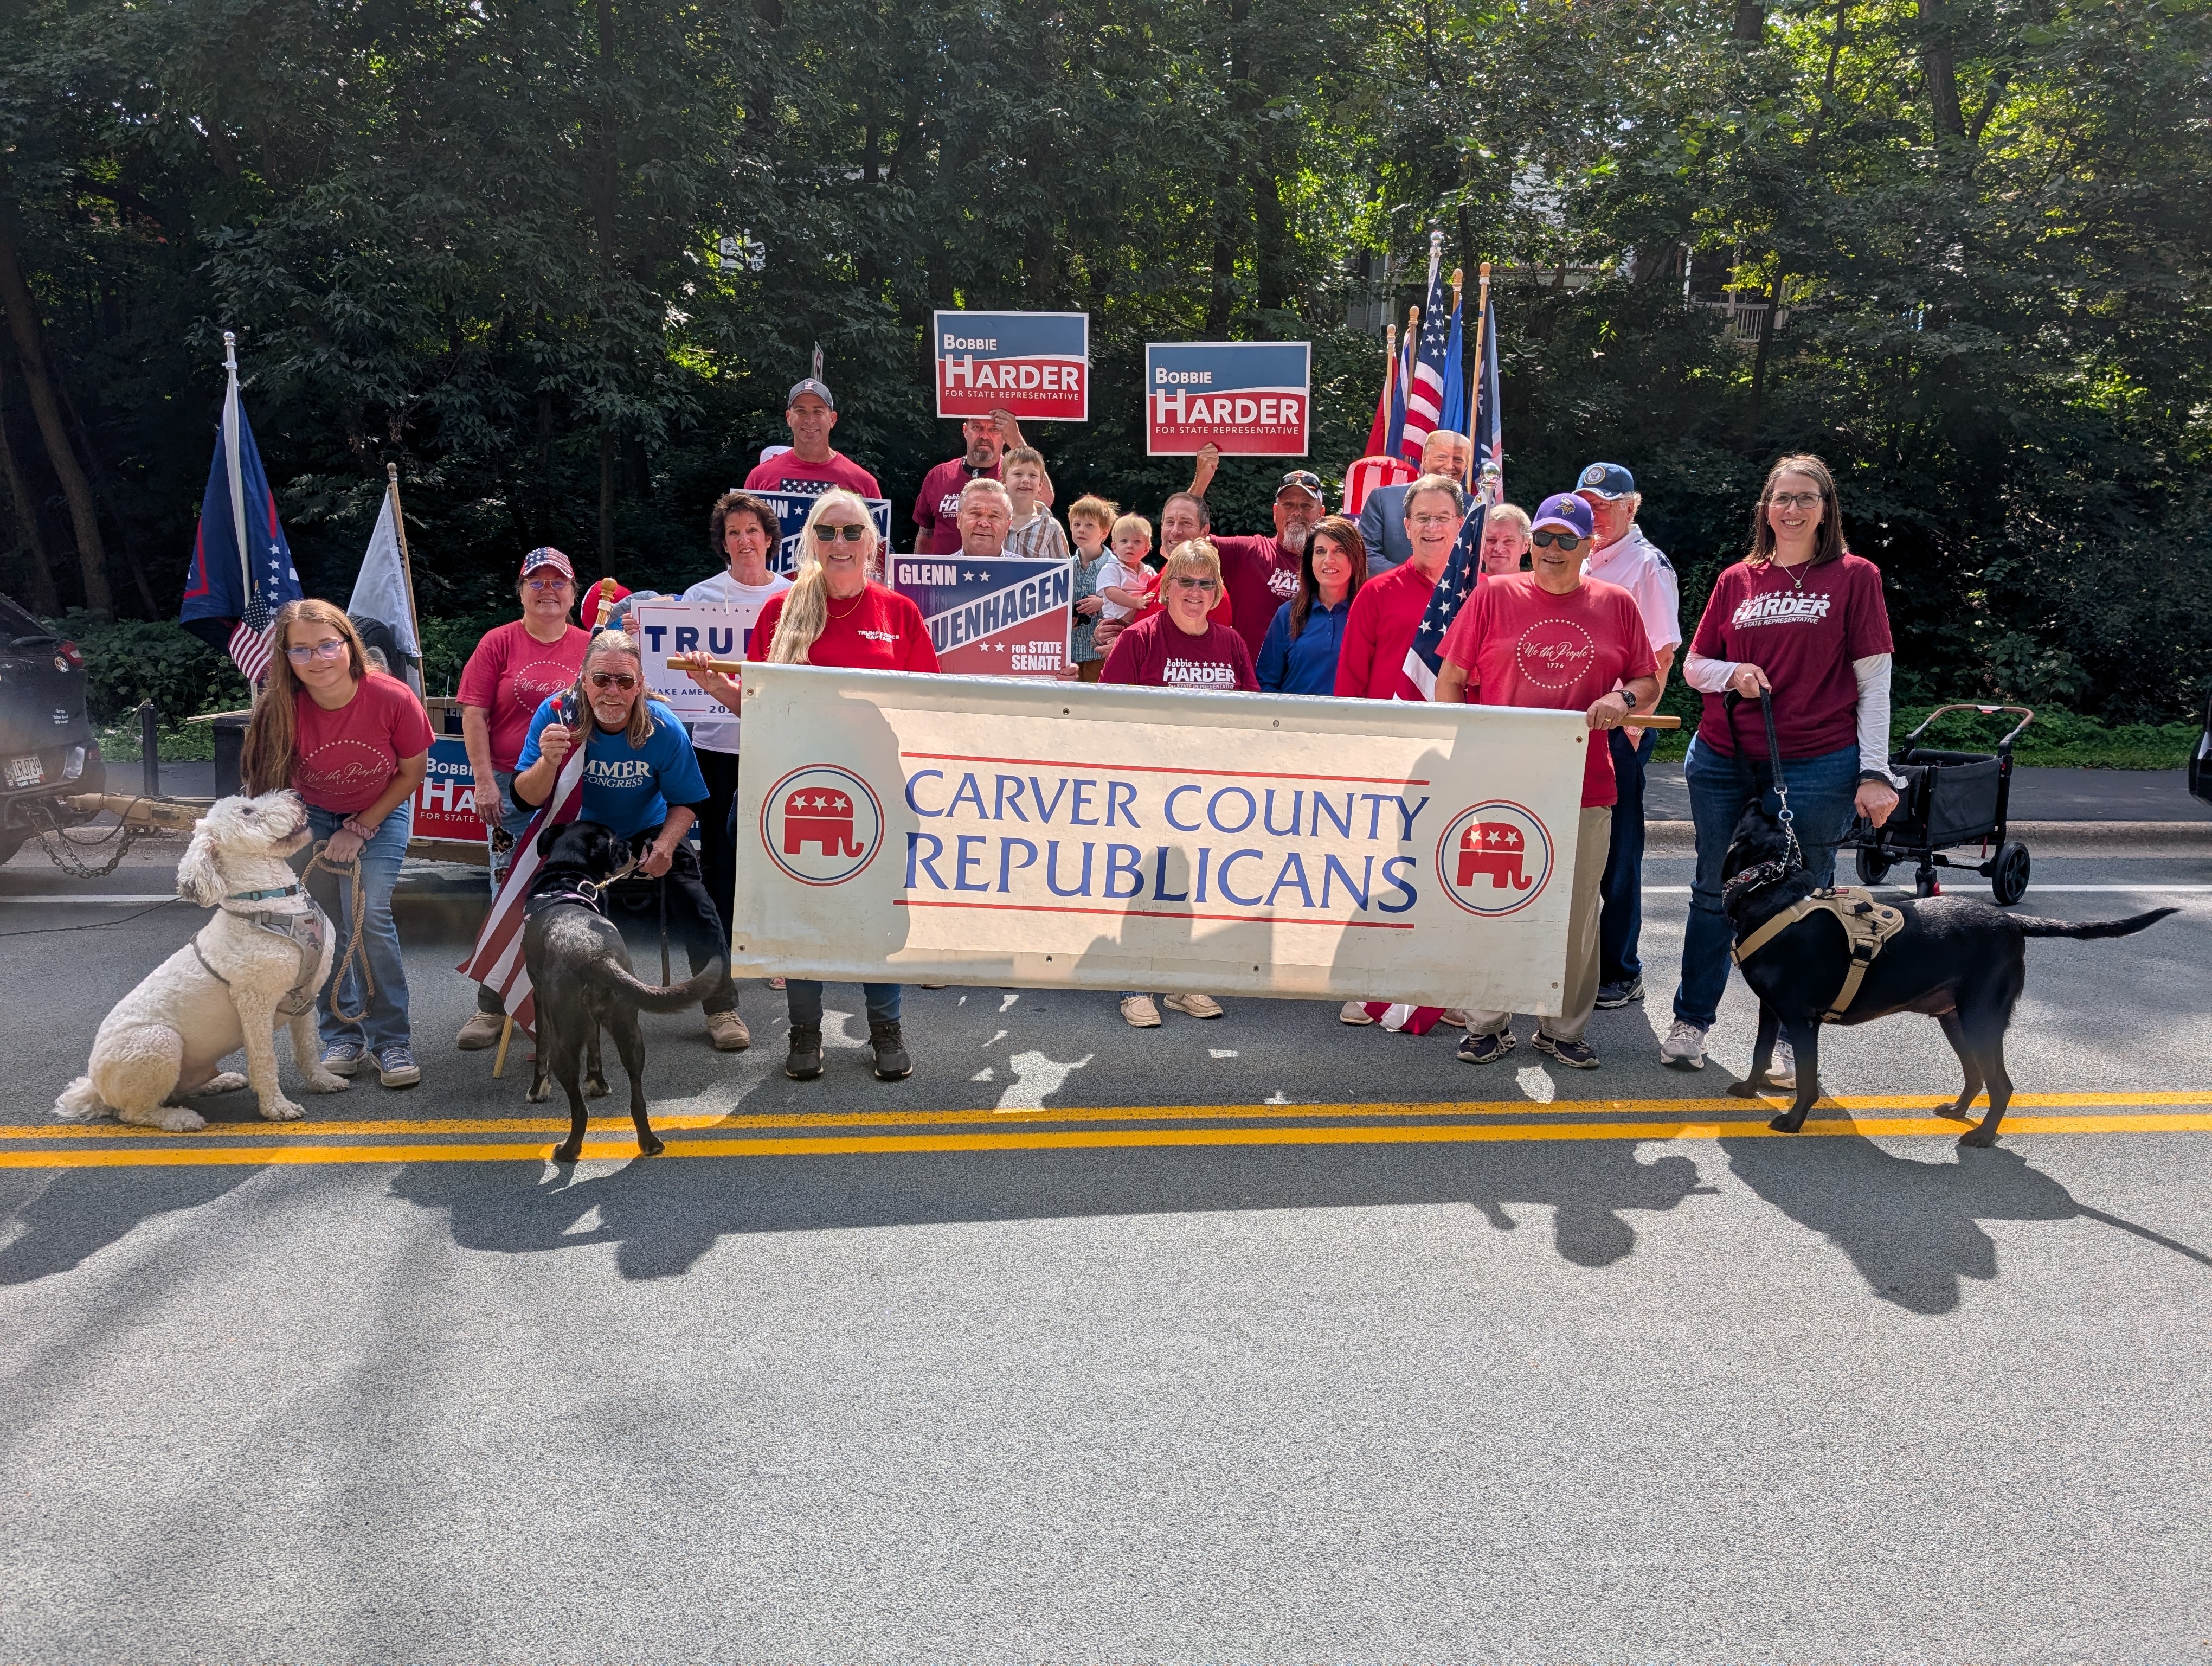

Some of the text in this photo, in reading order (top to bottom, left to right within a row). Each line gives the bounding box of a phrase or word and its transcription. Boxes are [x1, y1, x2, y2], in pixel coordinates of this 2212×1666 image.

[944, 334, 998, 350] BOBBIE
[945, 354, 1079, 391] HARDER
[1155, 367, 1212, 384] BOBBIE
[999, 392, 1079, 400] REPRESENTATIVE
[1156, 388, 1300, 425] HARDER
[1213, 426, 1299, 434] REPRESENTATIVE
[898, 563, 957, 586] GLENN
[1274, 567, 1297, 579] Bobbie
[1266, 574, 1301, 592] HAR
[1740, 591, 1772, 608] Bobbie
[925, 568, 1069, 653] UENHAGEN
[1731, 598, 1831, 624] HARDER
[1743, 620, 1763, 629] STATE
[1763, 616, 1819, 625] REPRESENTATIVE
[644, 625, 754, 655] TRU
[865, 635, 892, 643] CAPTAIN
[1011, 640, 1062, 654] FOR STATE
[1523, 641, 1589, 661] We the People
[1011, 655, 1061, 671] SENATE
[1166, 658, 1192, 668] Bobbie
[1162, 667, 1236, 683] HARDER
[519, 678, 537, 691] We
[536, 682, 551, 692] the
[709, 705, 732, 714] 20
[13, 758, 41, 778] 1RJ739
[302, 761, 384, 783] We the People
[427, 758, 472, 776] BOBBI
[583, 759, 652, 778] MMER
[583, 774, 644, 787] CONGRESS
[905, 769, 1430, 841] CARVER COUNTY
[420, 812, 440, 820] FOR
[445, 813, 474, 823] STATE
[904, 832, 1419, 913] REPUBLICANS
